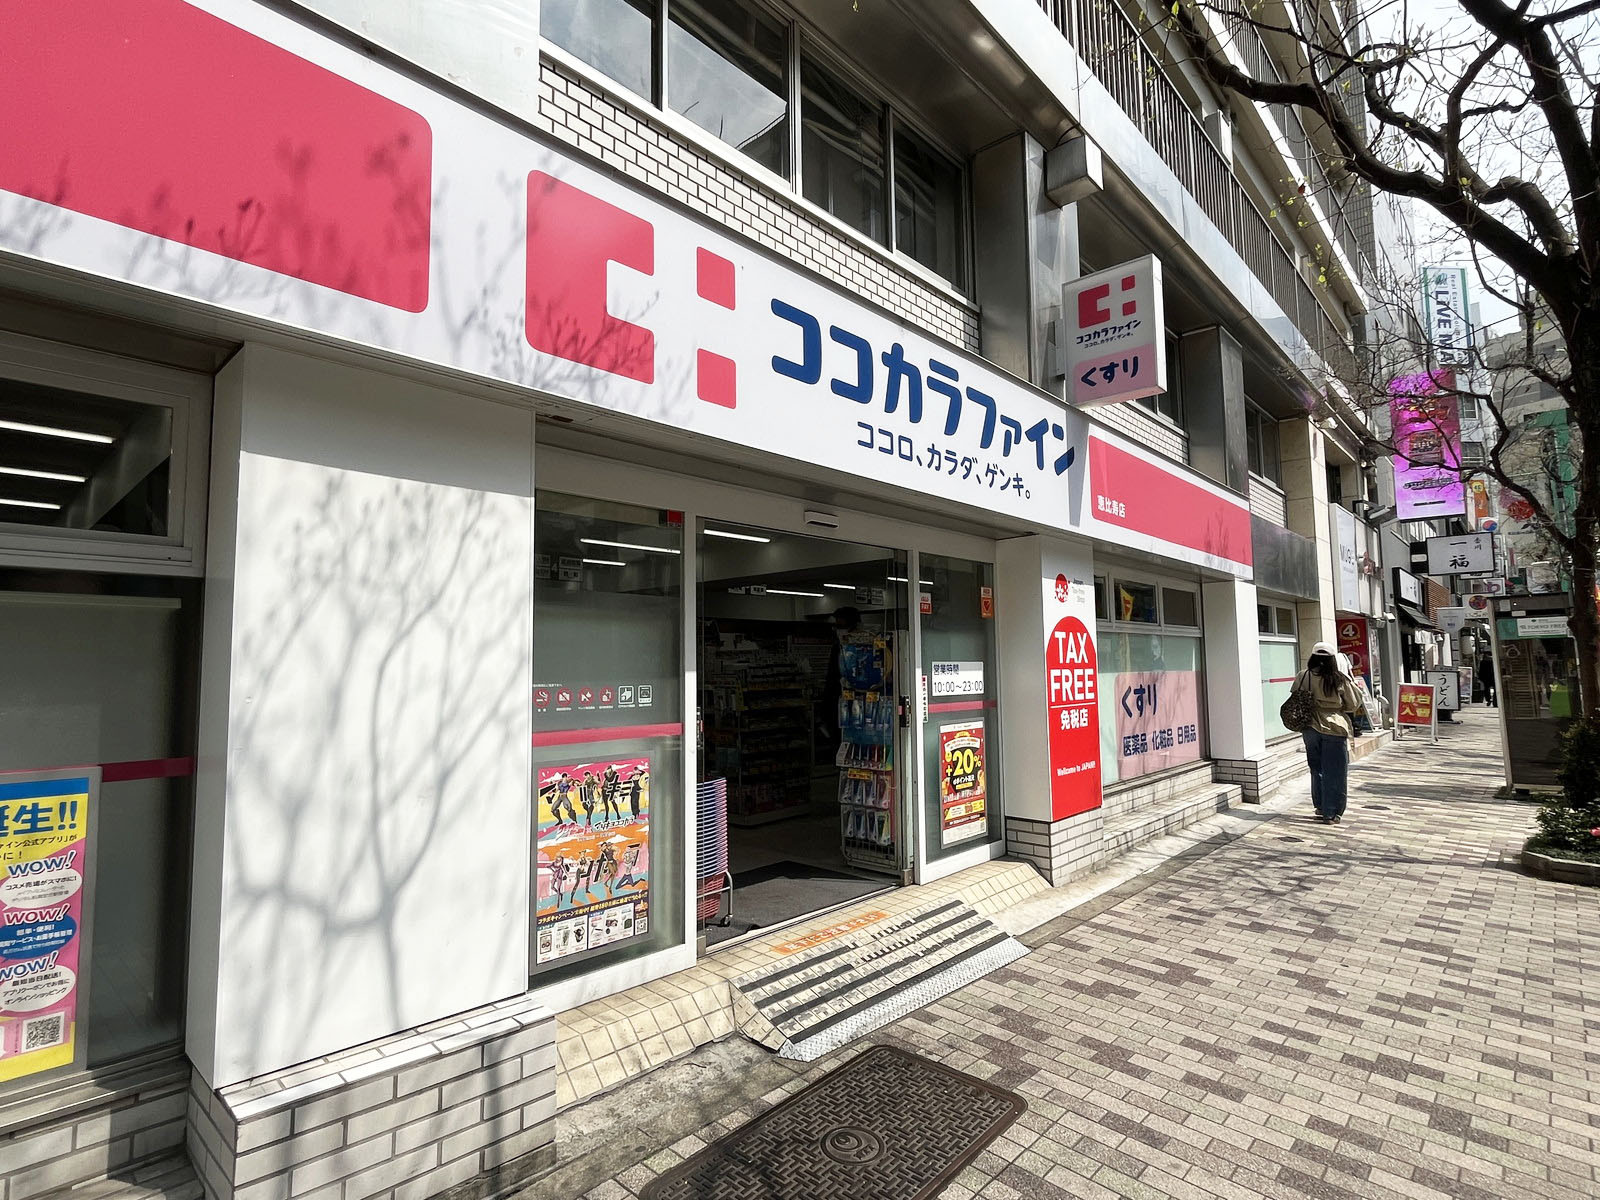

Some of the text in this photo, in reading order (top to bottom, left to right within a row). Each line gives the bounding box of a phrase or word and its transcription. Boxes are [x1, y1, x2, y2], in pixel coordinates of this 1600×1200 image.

[1076, 319, 1142, 345] ココカラファイン
[771, 298, 1075, 476] ココカラファイン
[1080, 355, 1139, 387] くすり
[857, 421, 1031, 500] ココロ、カラダ、ゲンキ。
[1096, 494, 1126, 518] 恵比寿店
[1054, 631, 1089, 664] TAX
[933, 663, 960, 675] 営業時間
[1050, 668, 1095, 702] FREE
[1121, 683, 1157, 718] くすり
[1438, 674, 1450, 707] うどん
[1060, 708, 1089, 731] 免税店
[1123, 724, 1197, 757] 医薬品 化粧品 日用品
[8, 850, 77, 878] WOW!
[5, 903, 71, 926] WOW!
